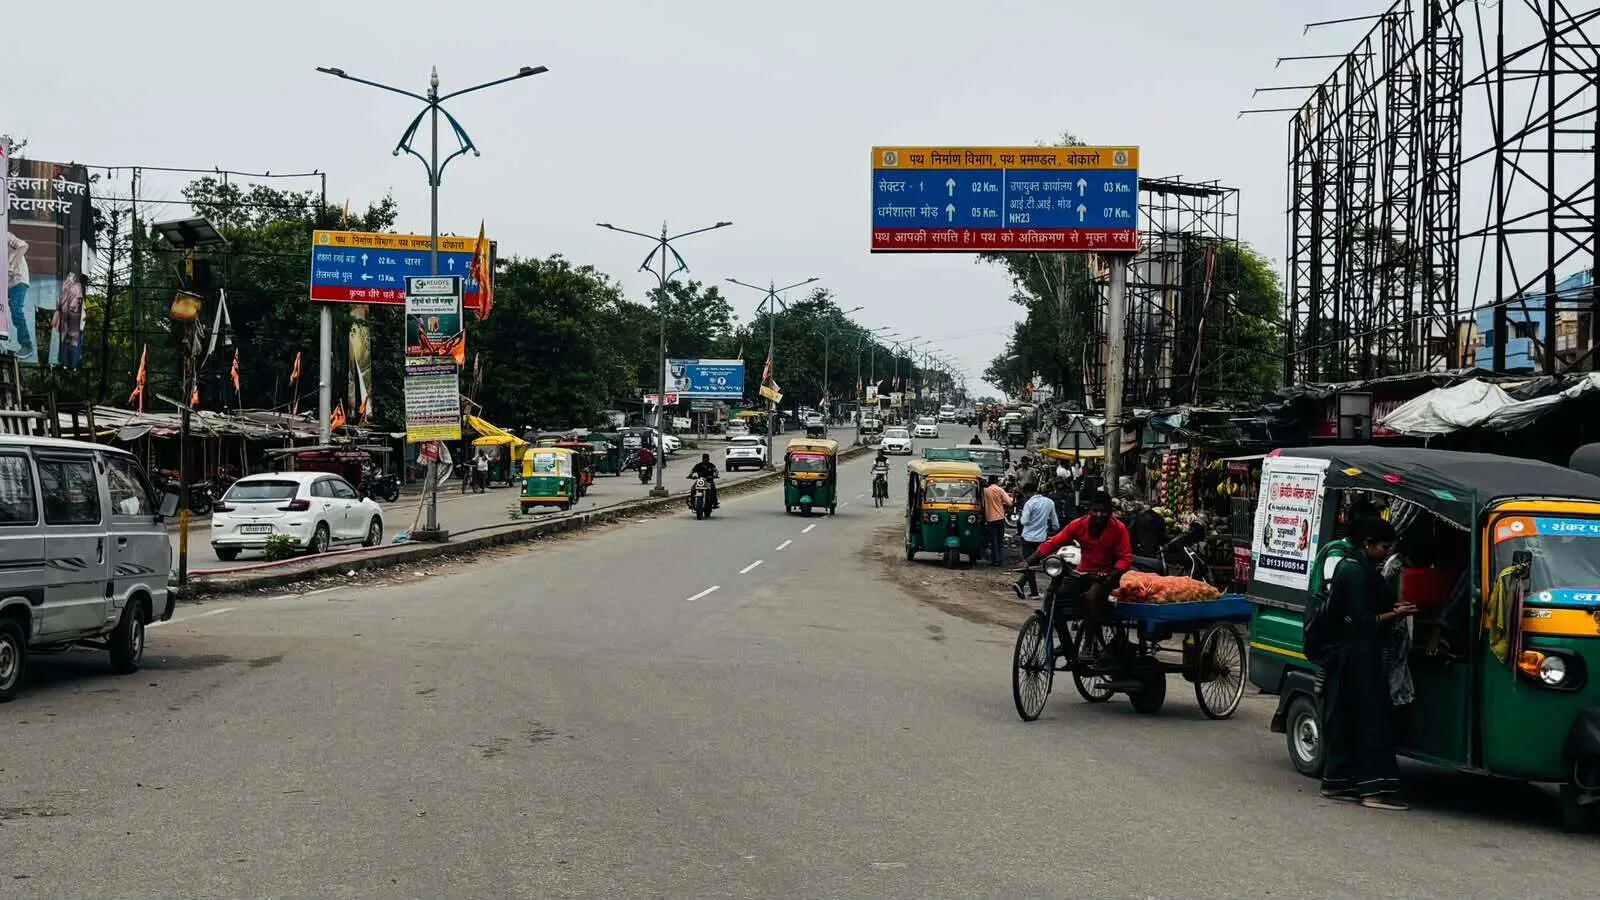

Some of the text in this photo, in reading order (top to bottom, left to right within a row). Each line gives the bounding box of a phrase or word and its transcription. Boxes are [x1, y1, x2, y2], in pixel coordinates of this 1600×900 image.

[909, 153, 925, 165] पथ
[931, 151, 961, 165] निर्माण
[965, 151, 997, 167] विभाग,
[1000, 153, 1015, 165] पथ
[1067, 151, 1100, 165] बोकारो
[8, 170, 48, 192] हँसता
[878, 178, 906, 192] सेक्टर
[919, 181, 924, 192] 1
[972, 182, 998, 192] 02 Km.
[1104, 182, 1130, 192] 03 Km.
[878, 203, 916, 217] धर्मशाला
[971, 207, 998, 217] 05 Km.
[1103, 208, 1131, 218] 07 Km.
[1009, 213, 1030, 223] NH23
[875, 232, 890, 241] पथ
[895, 229, 927, 242] आपकी
[981, 232, 996, 242] पथ
[1000, 229, 1014, 242] को
[1085, 232, 1107, 246] मुक्त
